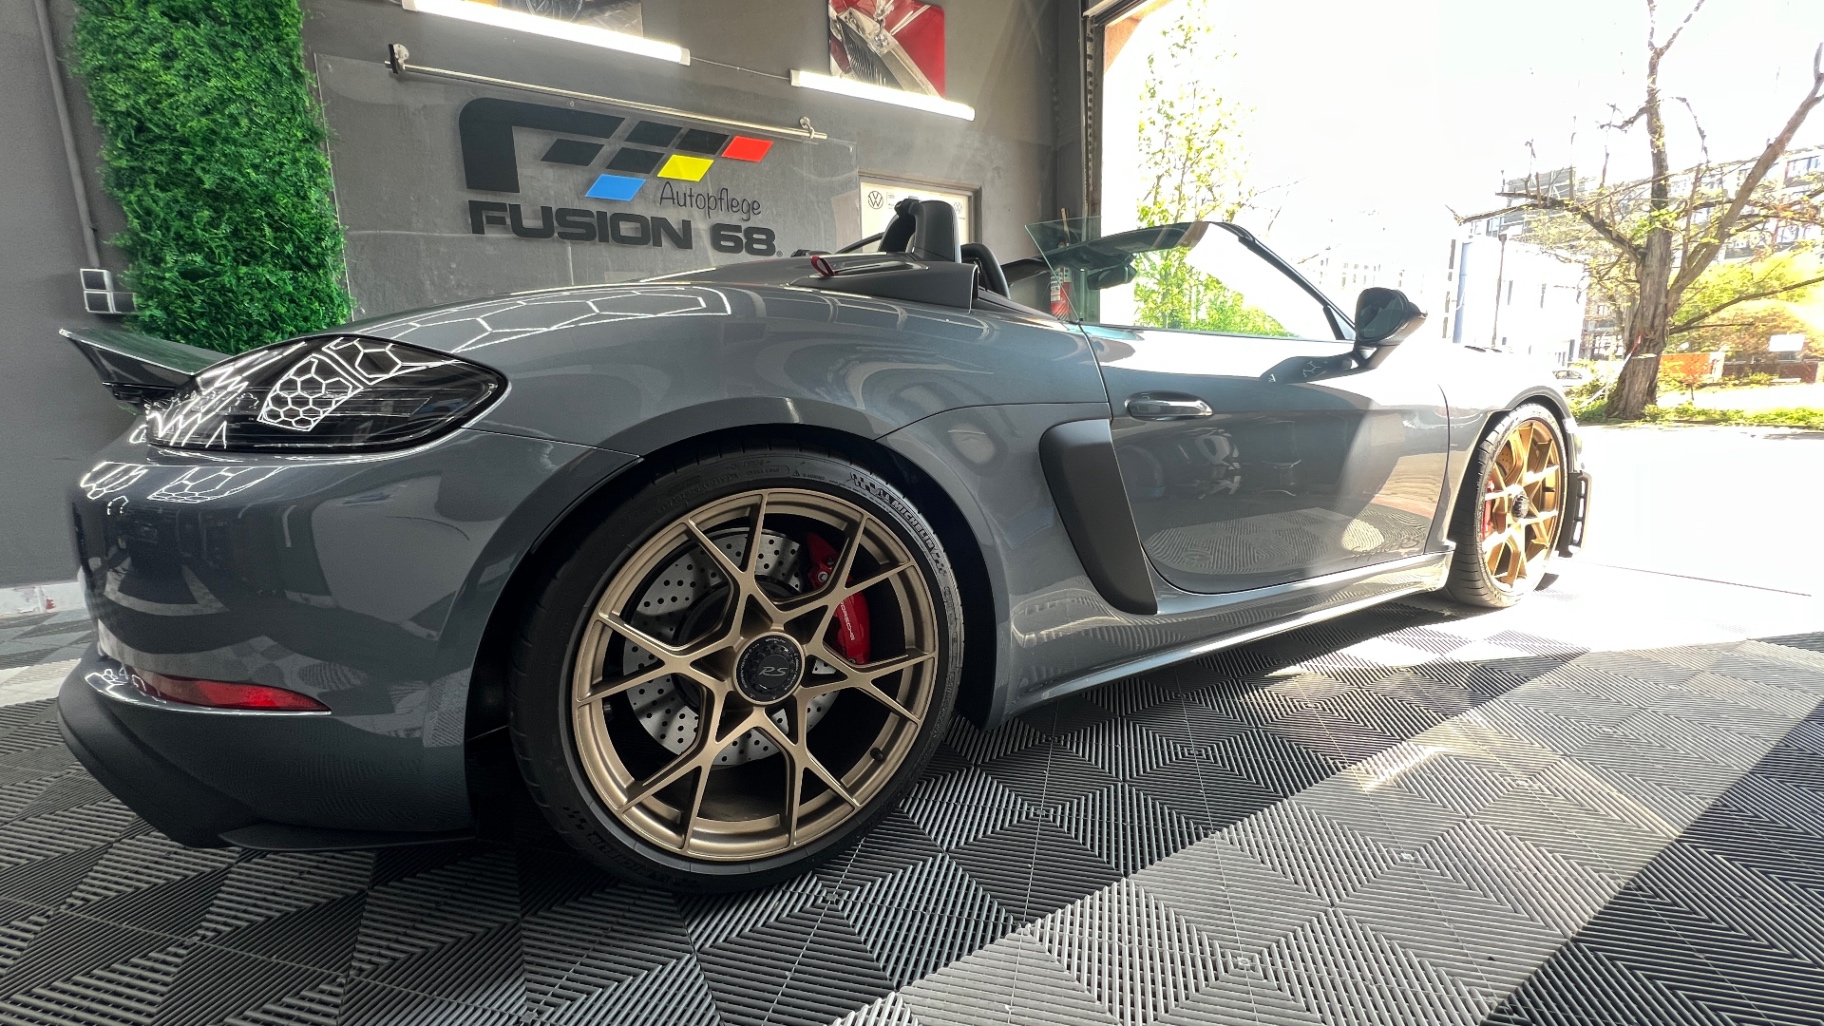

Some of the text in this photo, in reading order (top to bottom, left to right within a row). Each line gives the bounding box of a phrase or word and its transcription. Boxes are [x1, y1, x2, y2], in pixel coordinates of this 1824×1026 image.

[659, 181, 762, 221] Autopflege
[468, 200, 693, 250] FUSION
[891, 499, 935, 549] MICHELIN
[759, 666, 788, 677] RS
